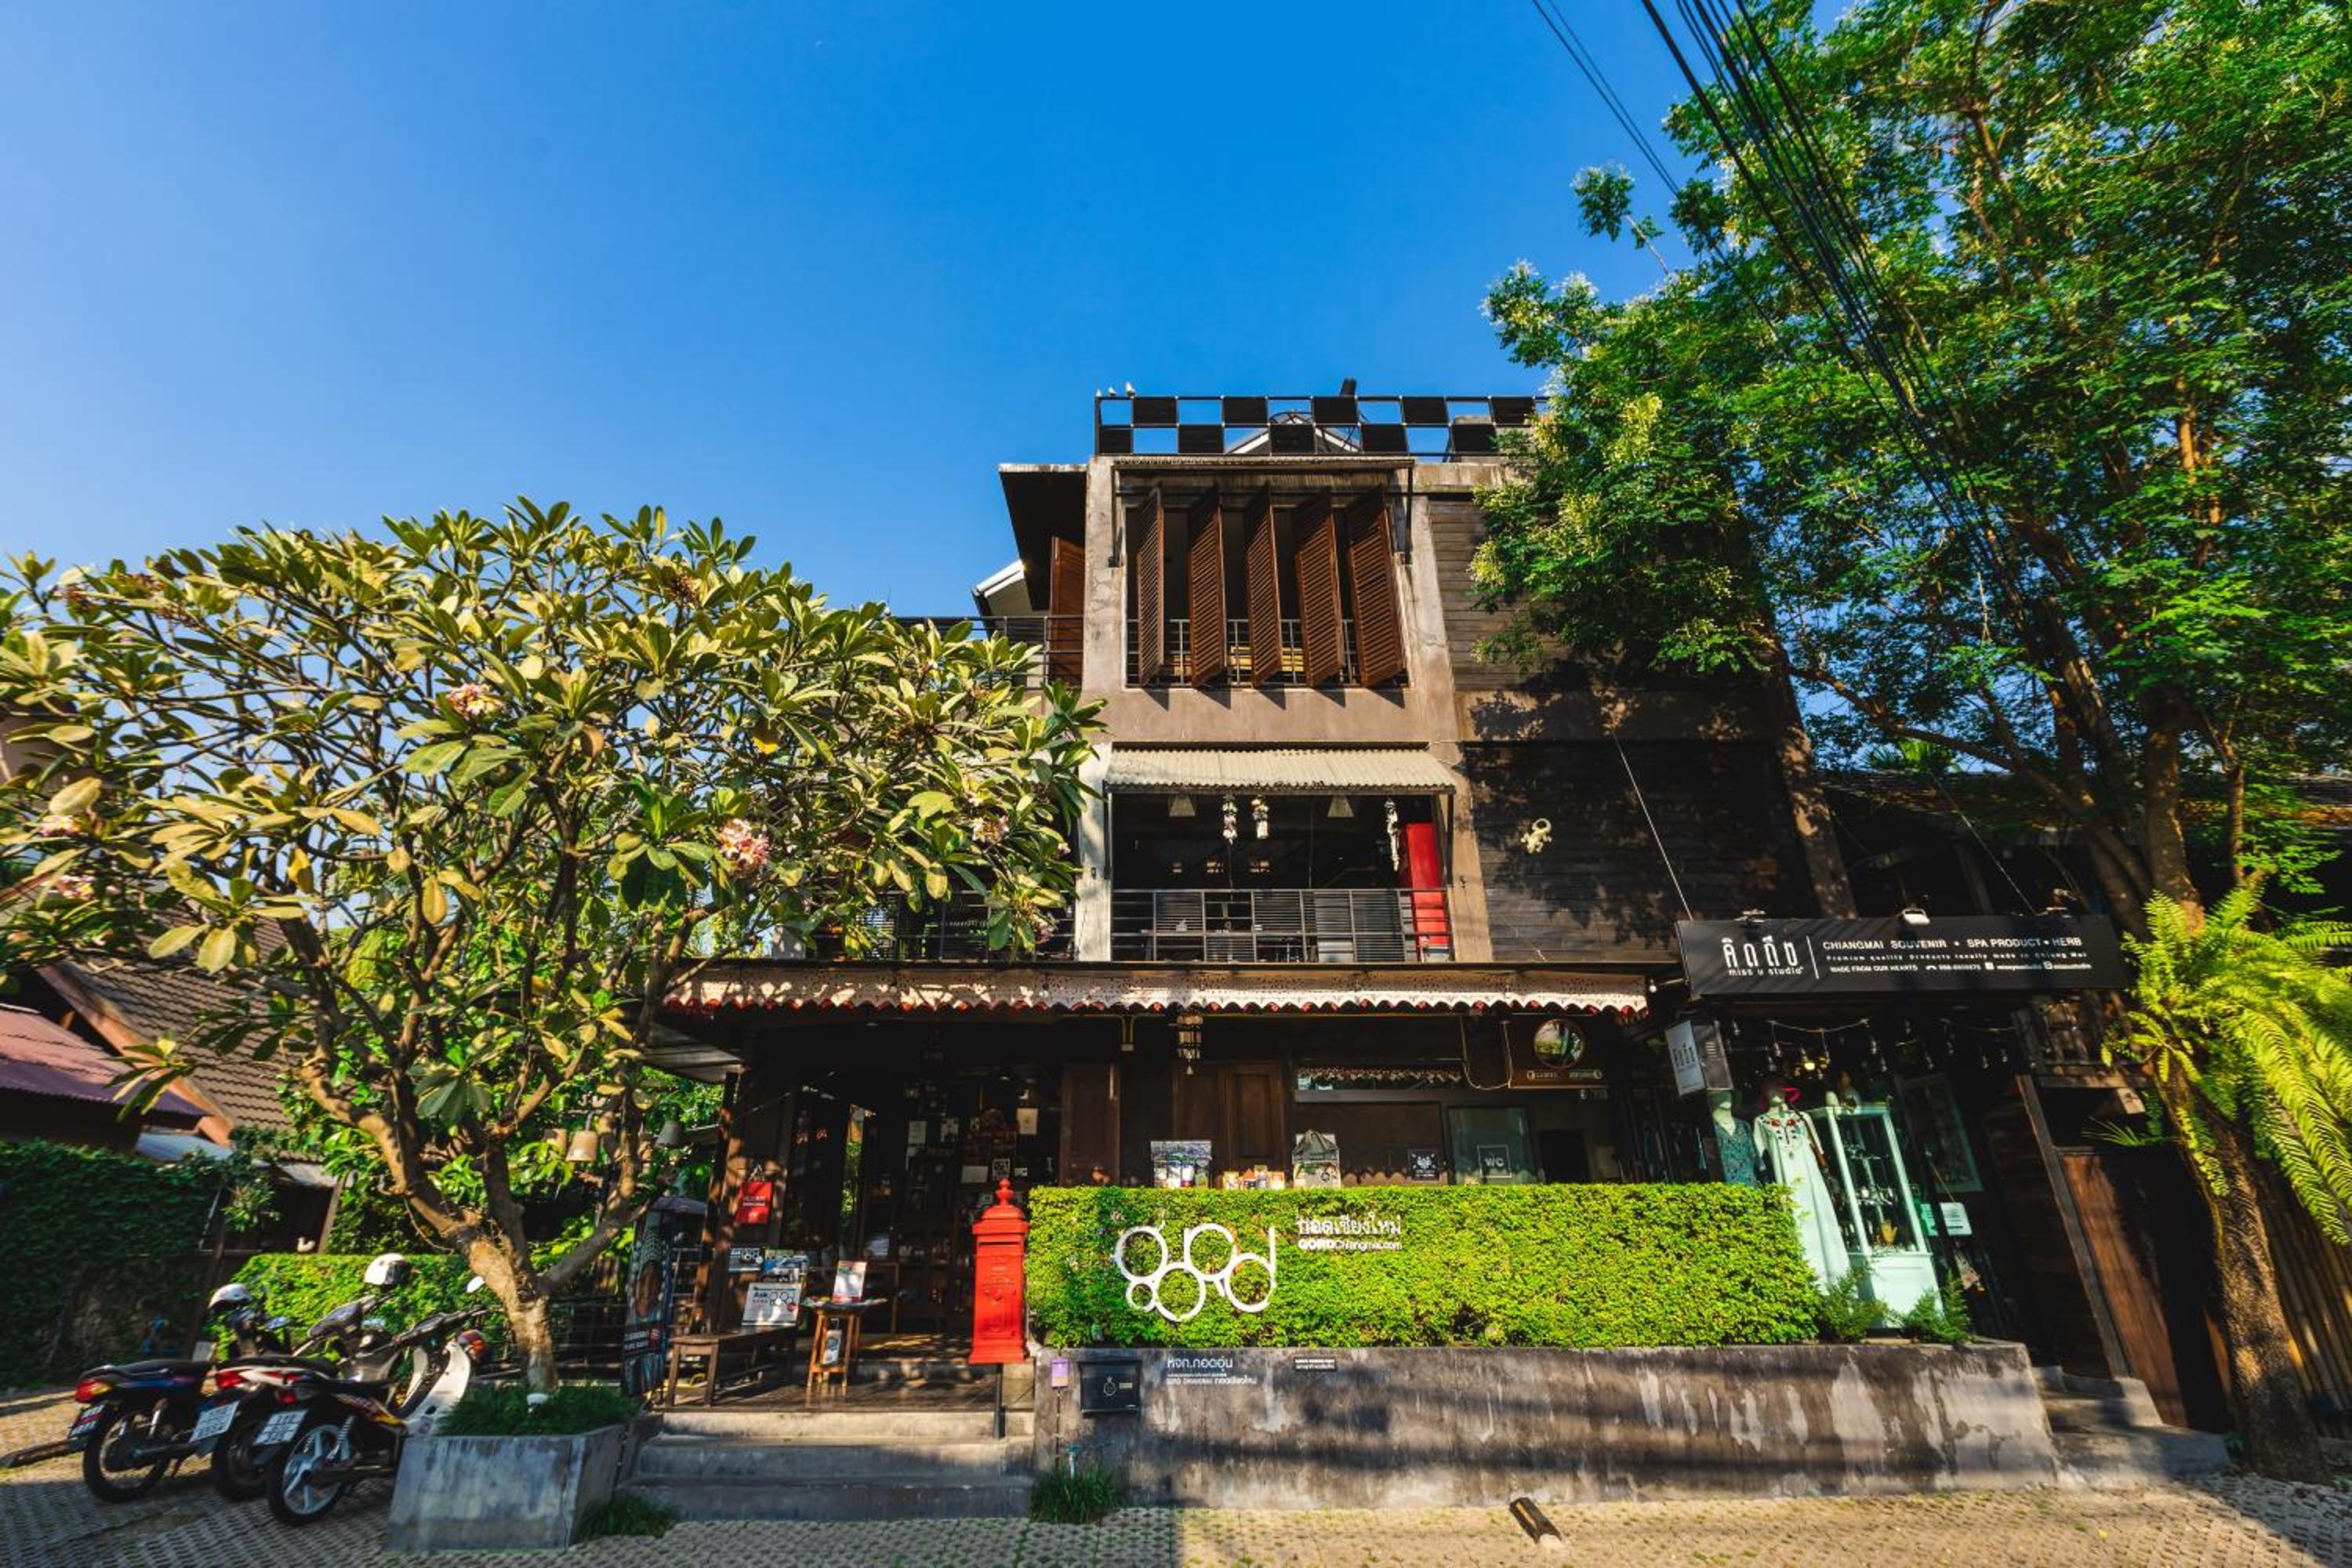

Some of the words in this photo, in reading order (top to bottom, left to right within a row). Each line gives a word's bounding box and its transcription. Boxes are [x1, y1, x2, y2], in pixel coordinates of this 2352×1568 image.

[1823, 941, 1884, 950] CHIANGMAI
[1890, 939, 1947, 949] SOUVENIR
[1966, 938, 1989, 948] SPA
[1991, 938, 2041, 947] PRODUCT
[2053, 937, 2082, 946] HERB
[1768, 966, 1802, 975] studio
[1483, 1156, 1505, 1168] WC
